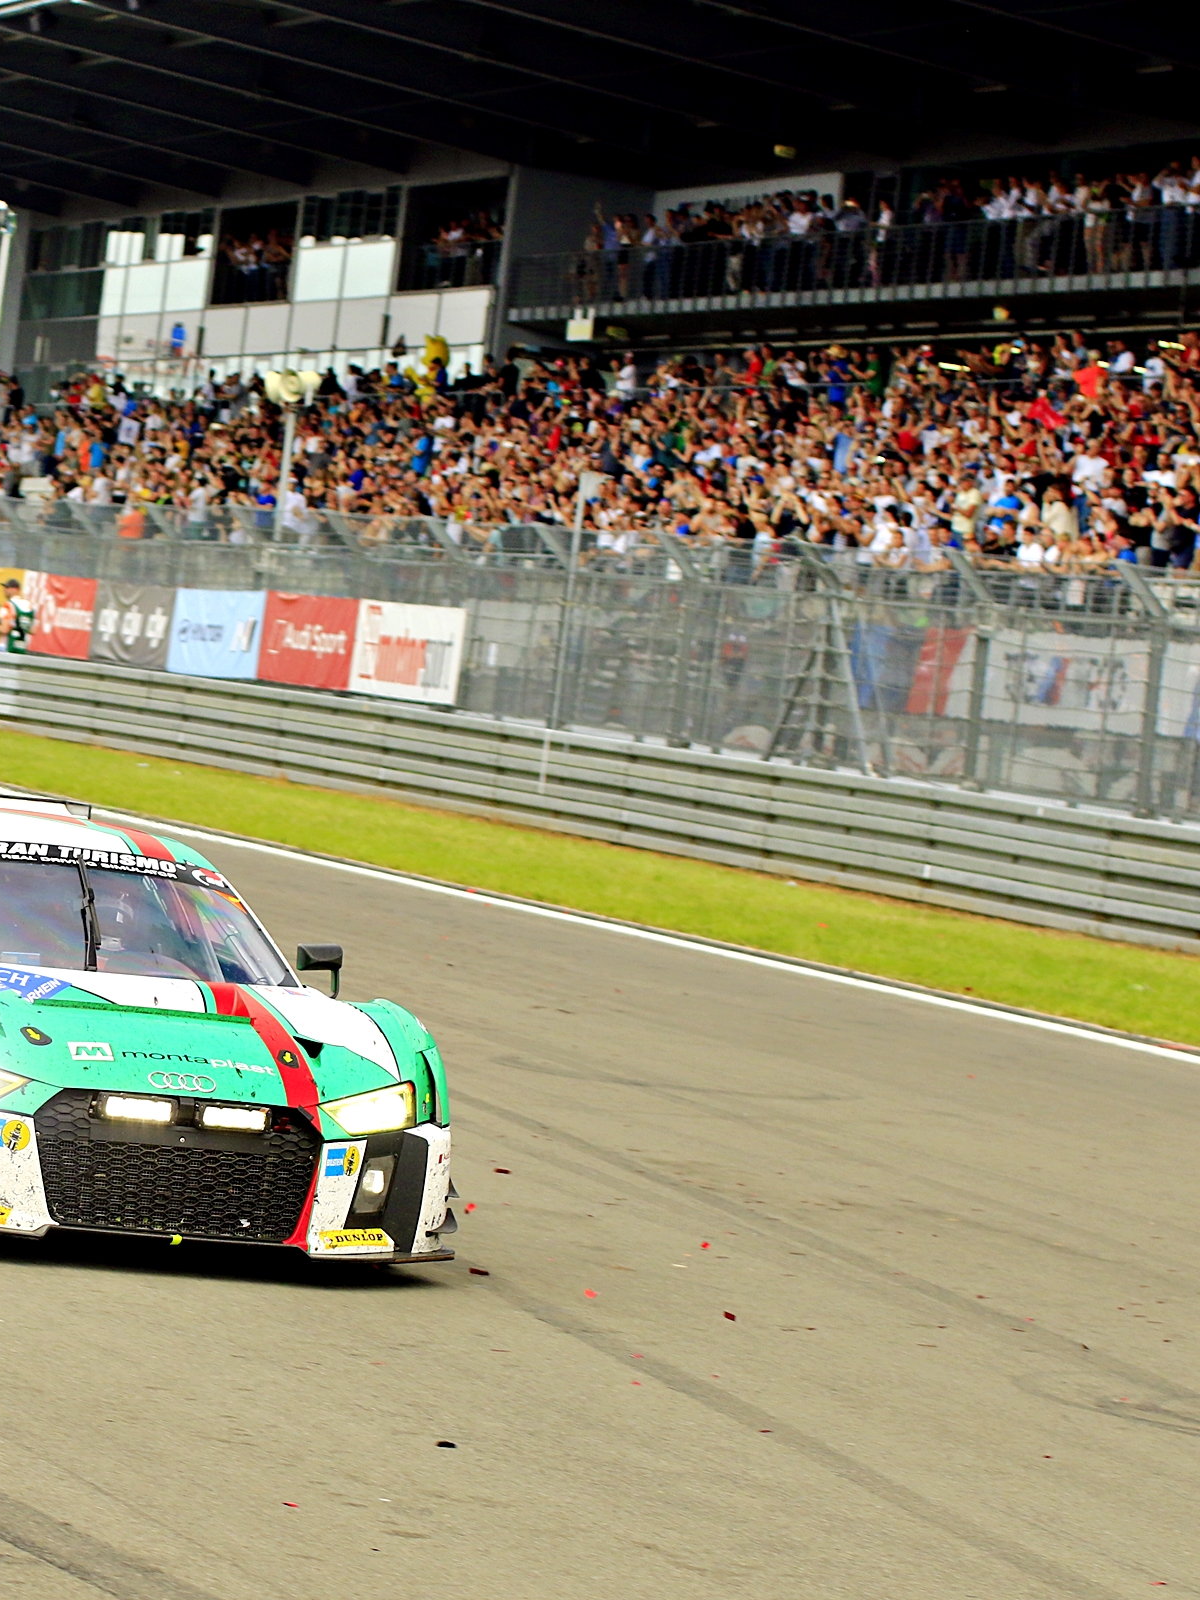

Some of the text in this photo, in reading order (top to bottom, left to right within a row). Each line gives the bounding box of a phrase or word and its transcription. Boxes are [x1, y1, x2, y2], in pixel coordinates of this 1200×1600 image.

[58, 845, 177, 873] TURISMO
[122, 1050, 276, 1076] montaplast
[335, 1232, 384, 1243] DUNLOP
